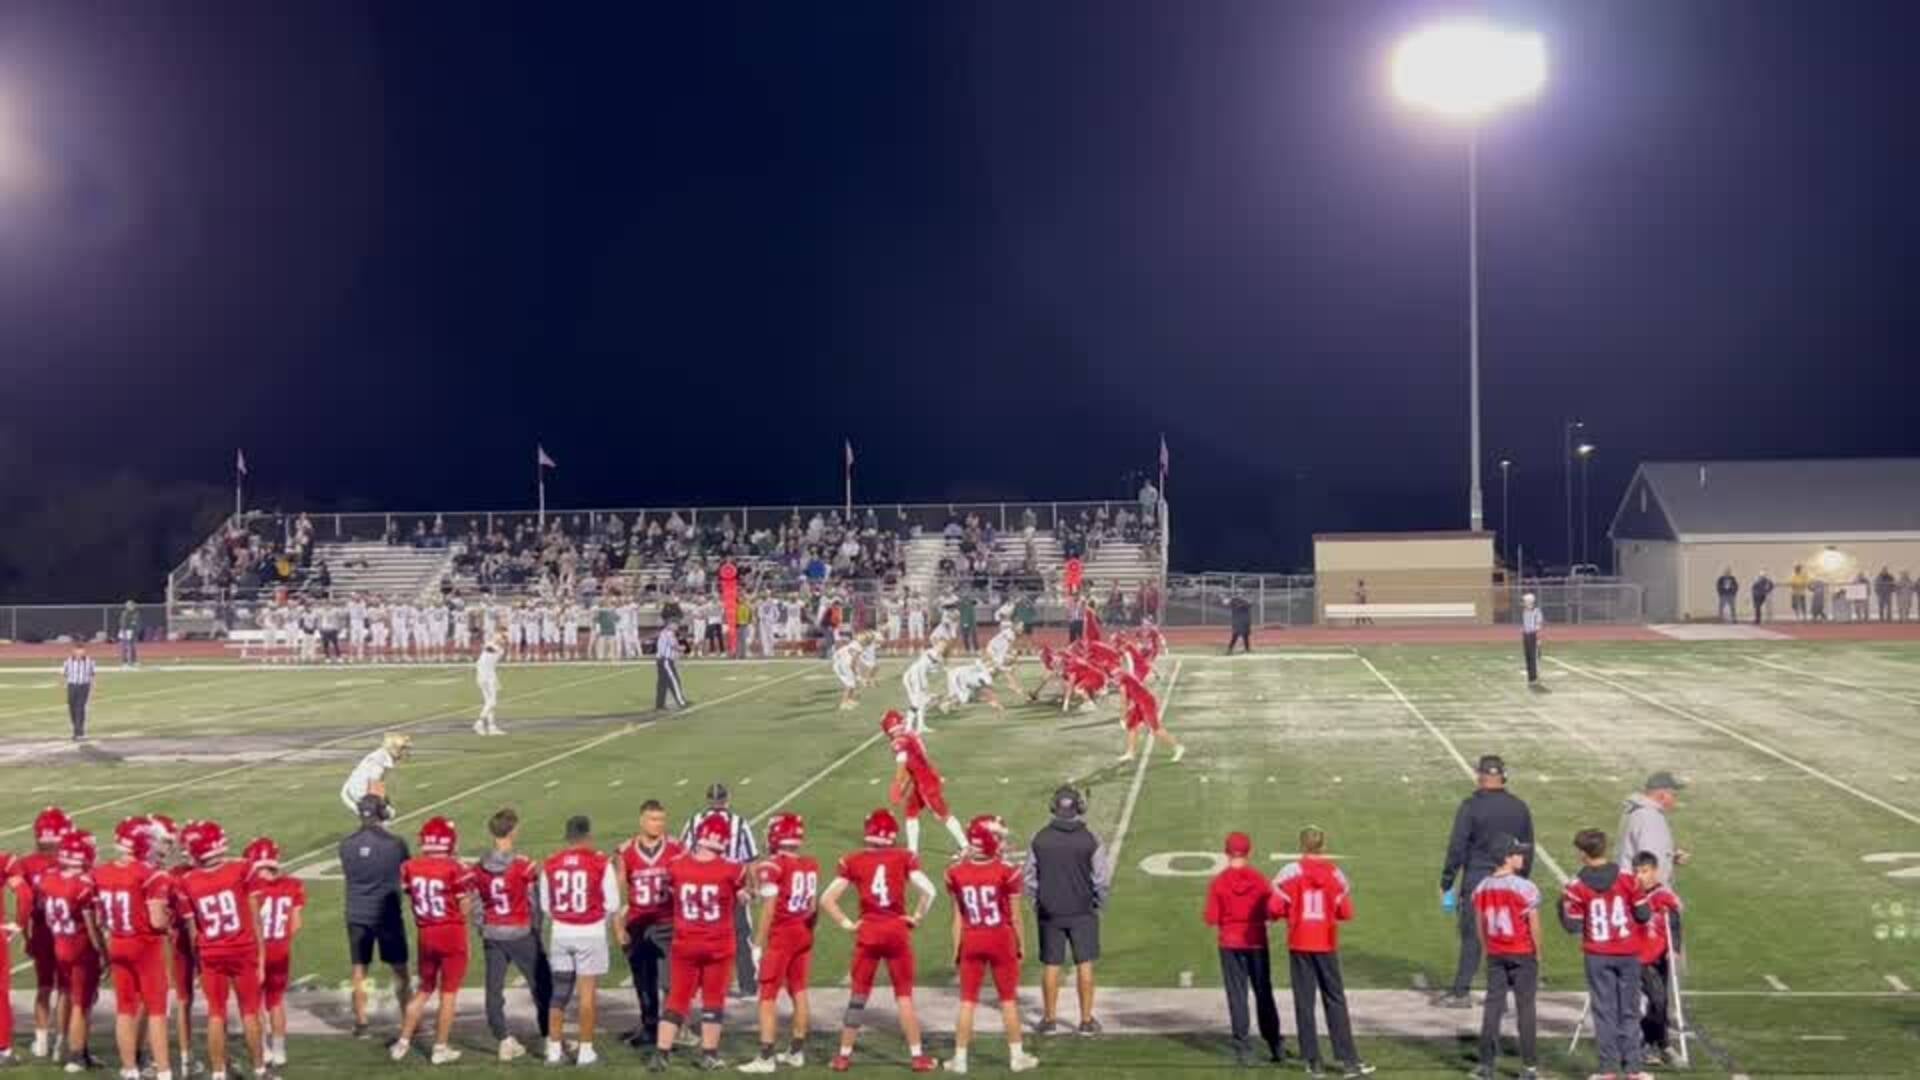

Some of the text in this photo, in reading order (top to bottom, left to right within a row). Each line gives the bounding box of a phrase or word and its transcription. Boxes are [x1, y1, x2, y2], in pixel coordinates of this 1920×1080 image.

[412, 876, 446, 917] 36
[490, 877, 510, 914] 5
[554, 869, 588, 912] 28
[680, 883, 720, 920] 65
[871, 863, 890, 907] 4
[198, 889, 241, 938] 59
[1590, 895, 1630, 940] 84
